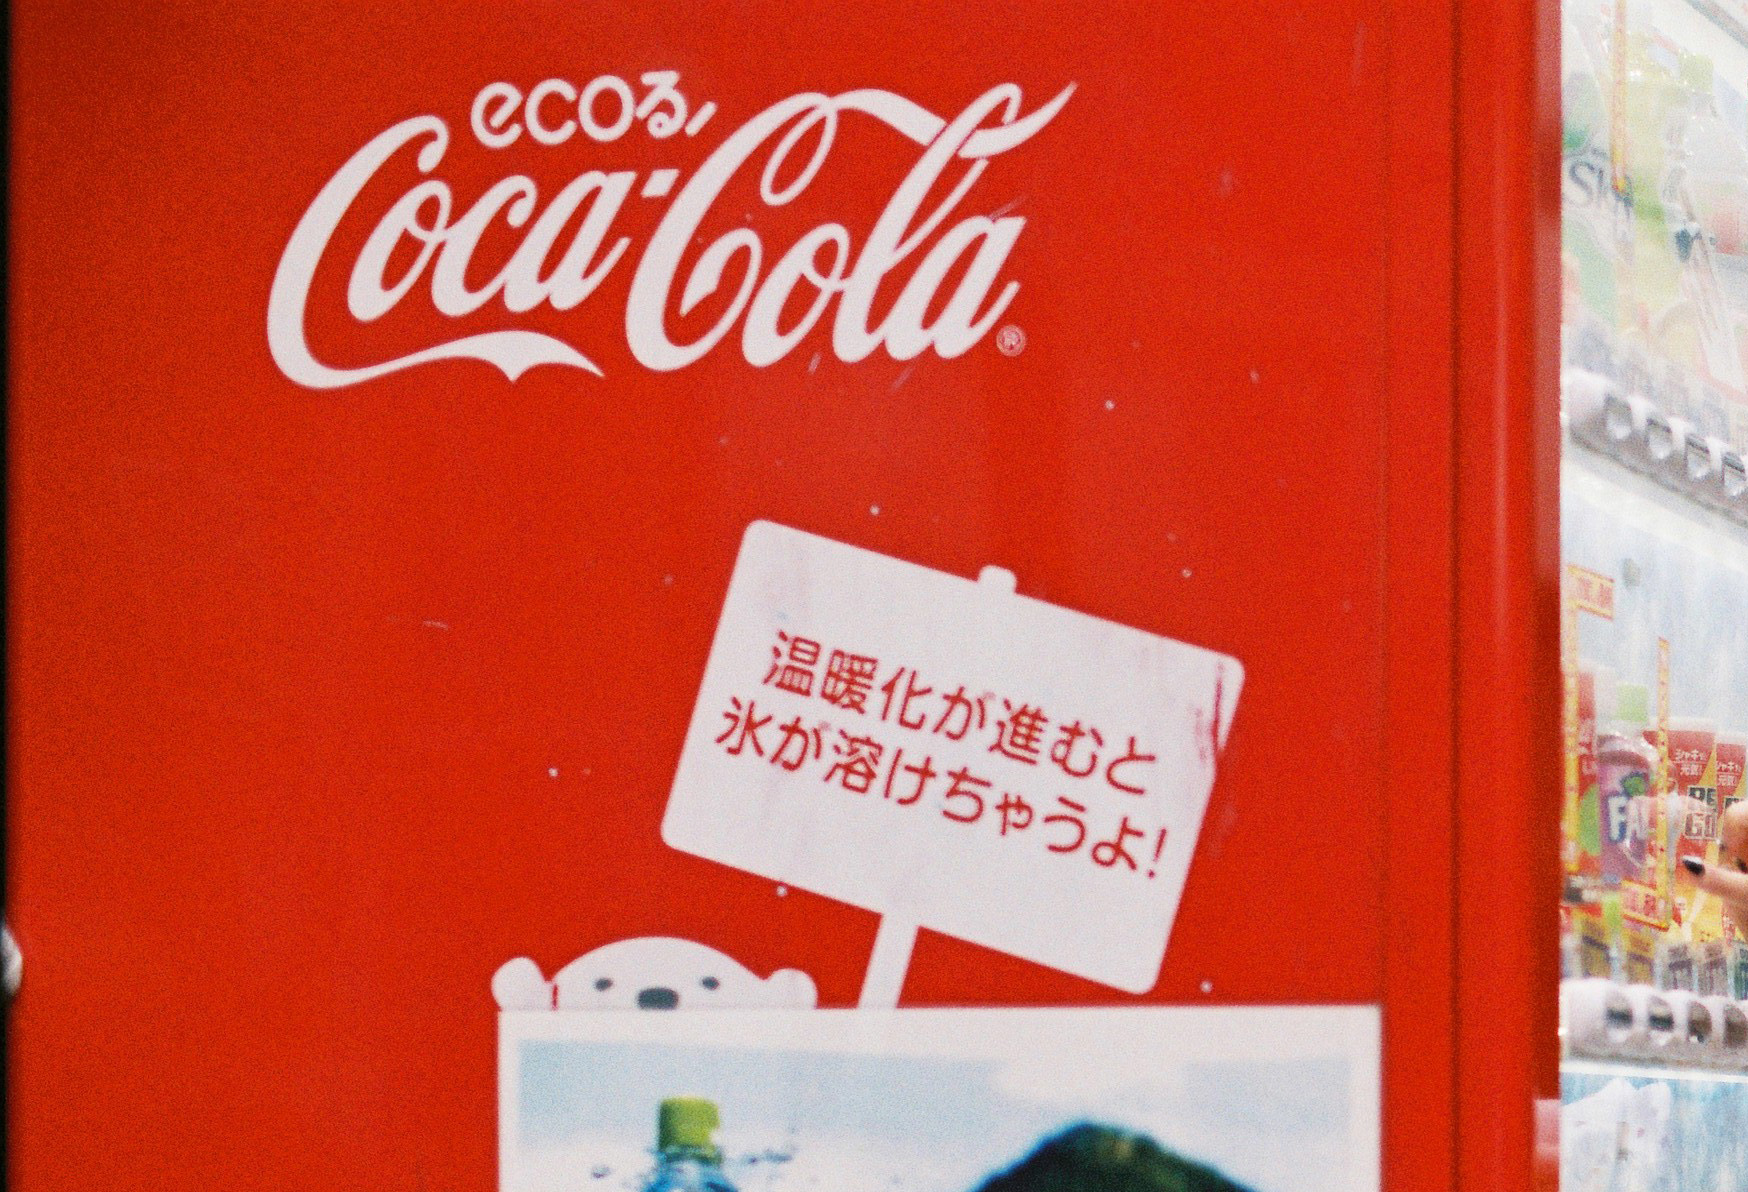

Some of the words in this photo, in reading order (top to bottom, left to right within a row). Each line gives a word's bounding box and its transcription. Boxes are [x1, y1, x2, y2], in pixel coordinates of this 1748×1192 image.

[266, 82, 1077, 389] Coca-Cola
[762, 629, 1157, 796] 温暖化が進むと
